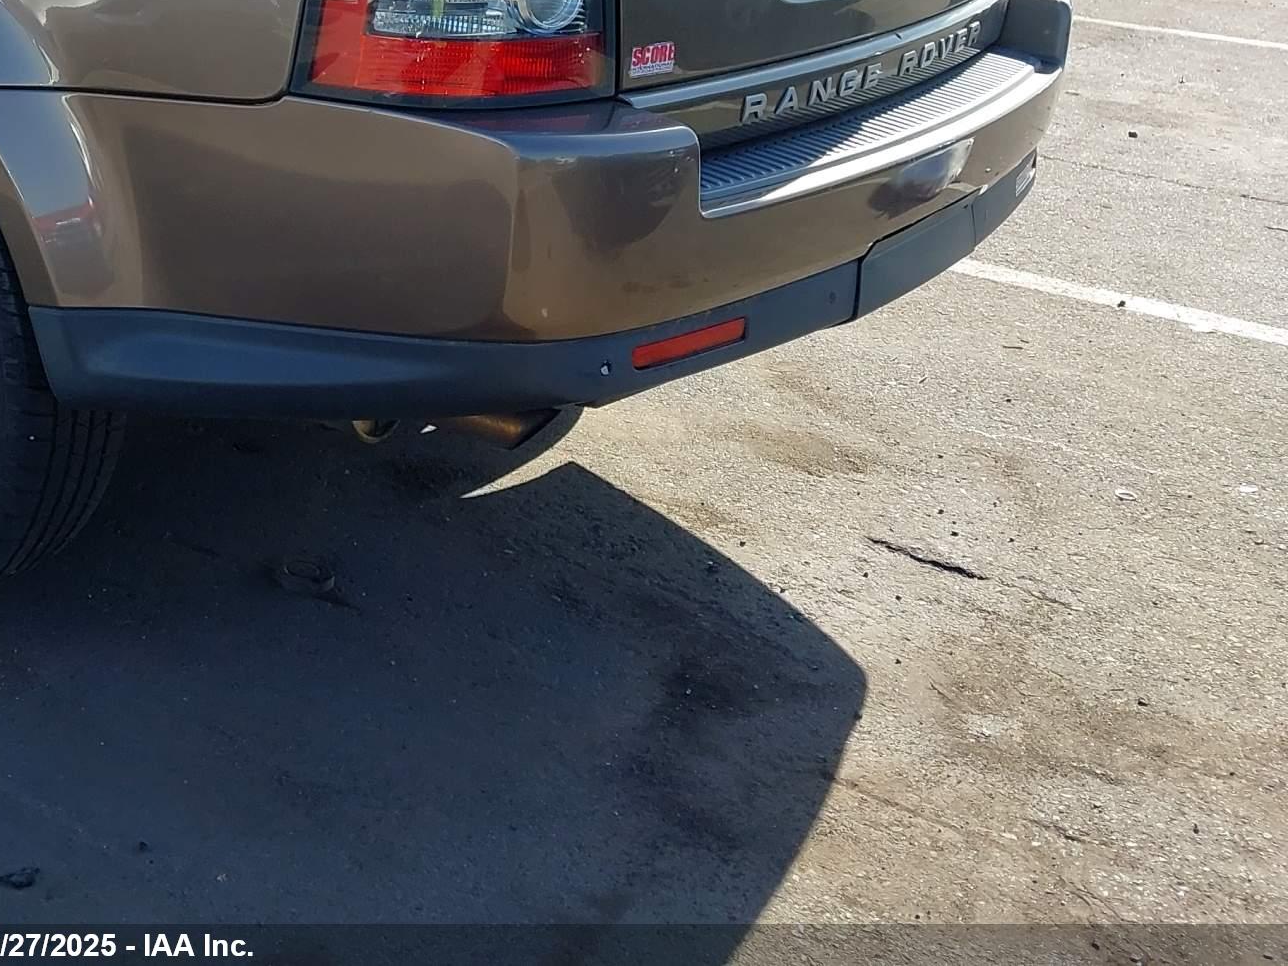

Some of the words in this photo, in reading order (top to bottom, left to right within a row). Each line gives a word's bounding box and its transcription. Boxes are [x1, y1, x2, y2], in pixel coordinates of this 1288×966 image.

[632, 44, 675, 67] SCORE
[739, 62, 883, 125] RANGE
[898, 20, 982, 77] ROVER
